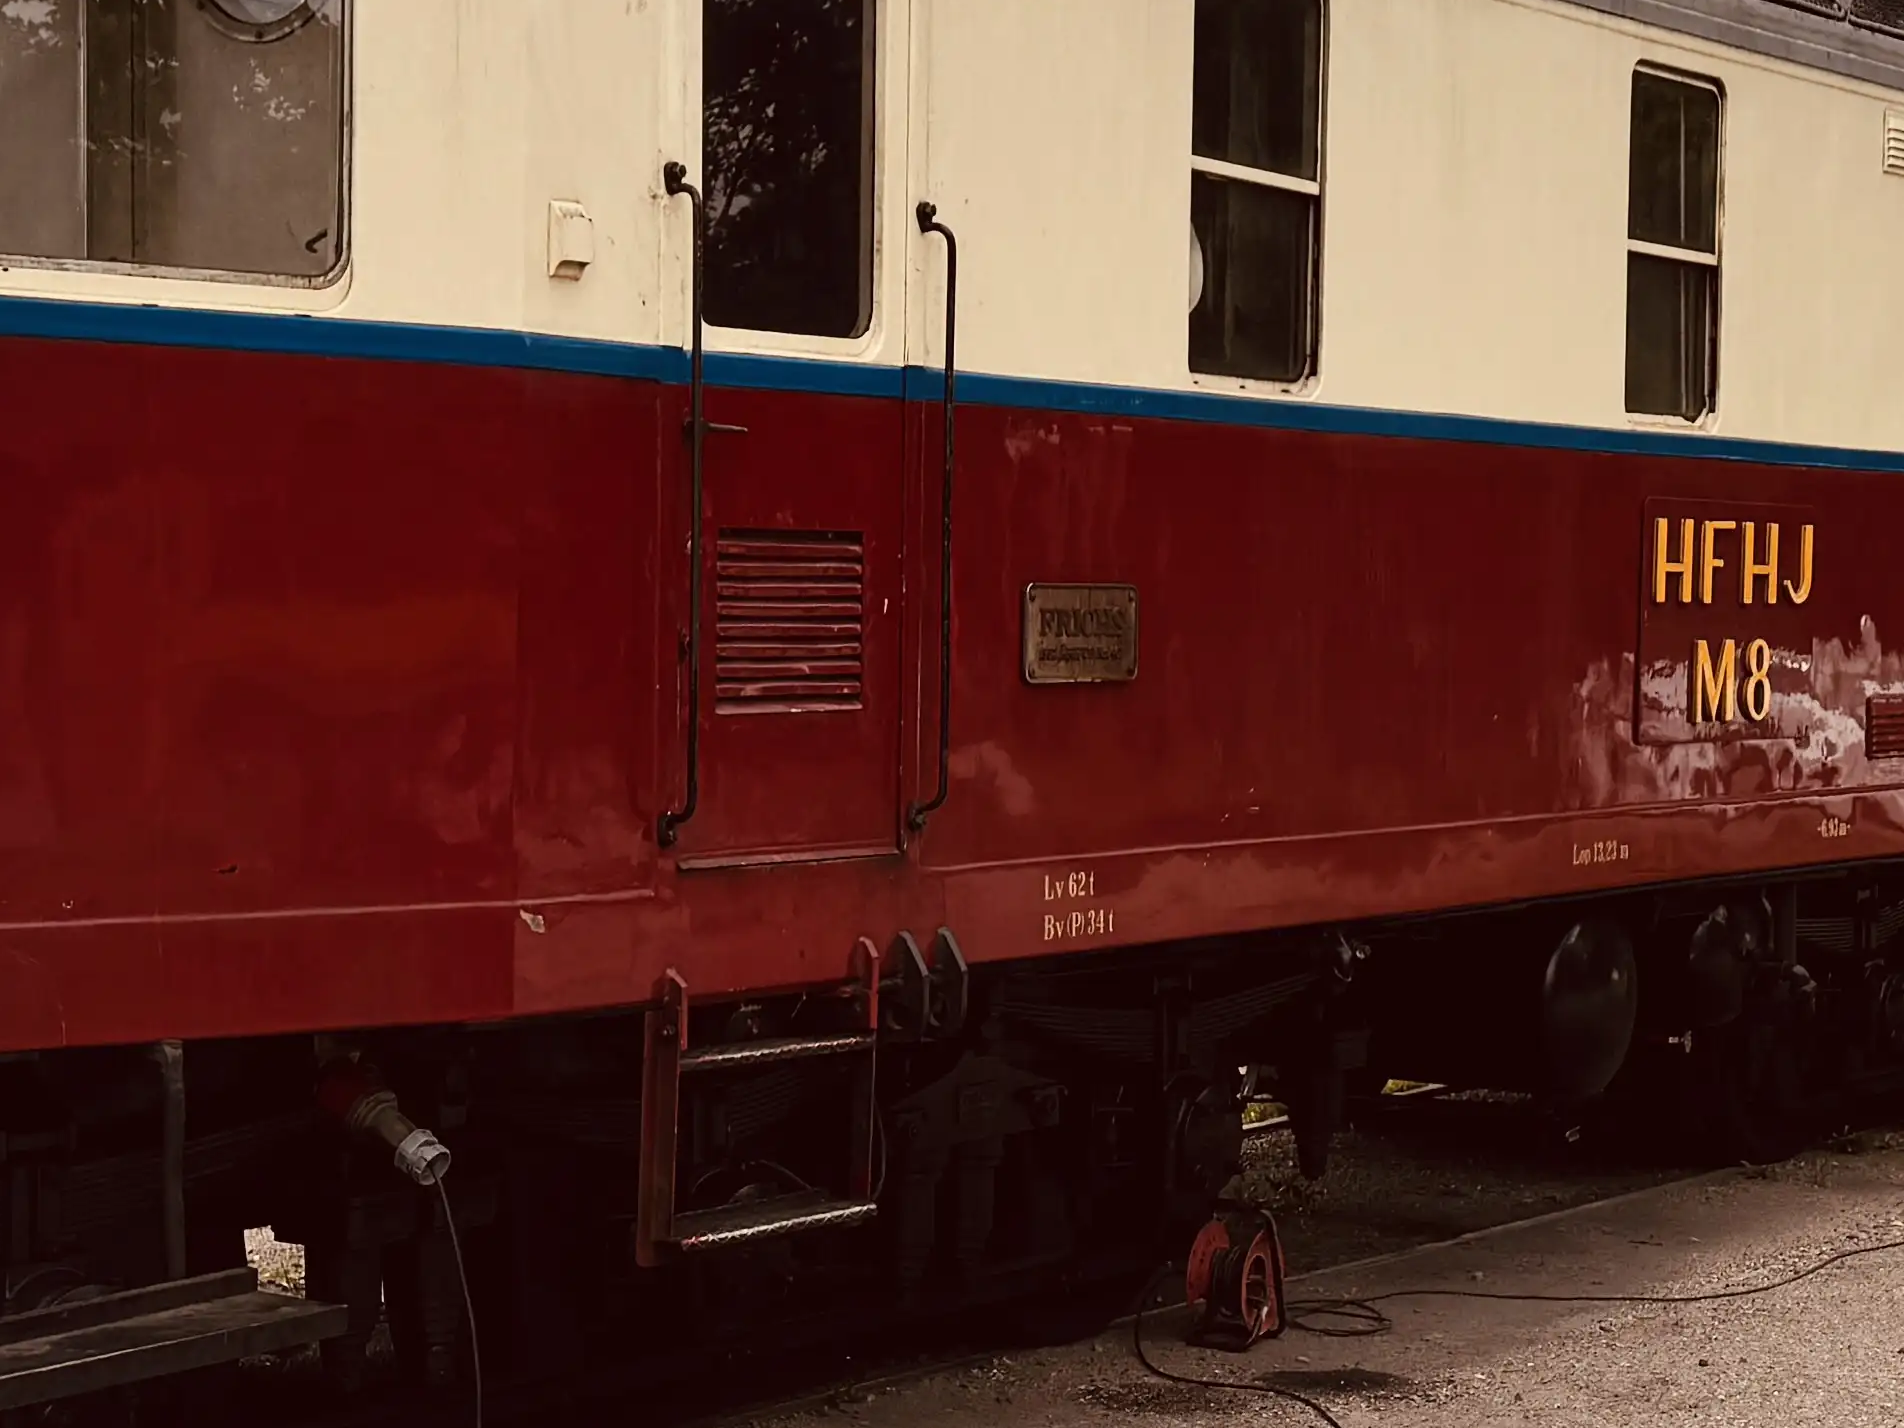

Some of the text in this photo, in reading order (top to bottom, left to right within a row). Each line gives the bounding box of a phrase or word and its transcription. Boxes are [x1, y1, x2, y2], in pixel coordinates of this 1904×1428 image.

[1653, 517, 1814, 605] HFHJ
[1693, 638, 1772, 723] M8
[1044, 871, 1094, 900] Lv 62 t
[1088, 909, 1104, 935] 34
[1109, 908, 1114, 932] t
